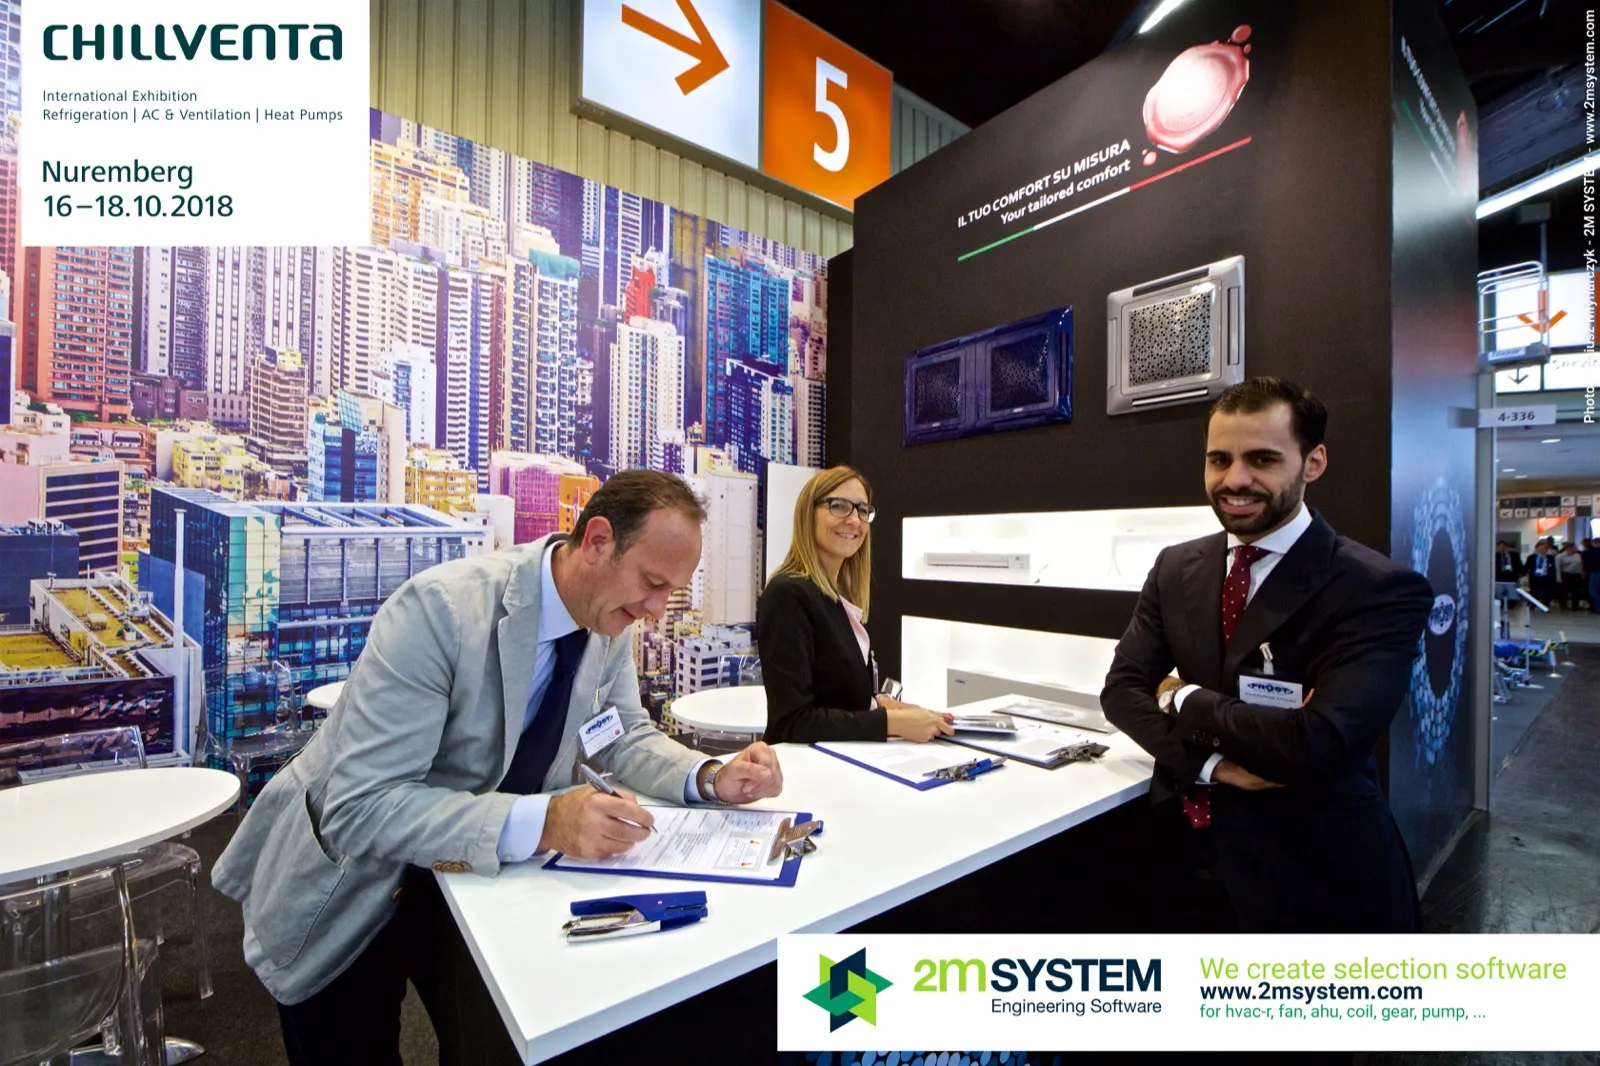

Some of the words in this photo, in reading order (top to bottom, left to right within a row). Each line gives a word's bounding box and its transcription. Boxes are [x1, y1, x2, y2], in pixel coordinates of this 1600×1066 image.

[814, 57, 850, 172] 5
[957, 216, 967, 229] IL
[968, 204, 991, 223] TUO
[992, 175, 1051, 211] COMFORT
[1053, 165, 1071, 184] SU
[1074, 138, 1131, 176] MISURA
[1000, 207, 1026, 225] Your
[1028, 182, 1074, 213] tailored
[1076, 159, 1131, 192] comfort
[1498, 411, 1535, 422] 4-336
